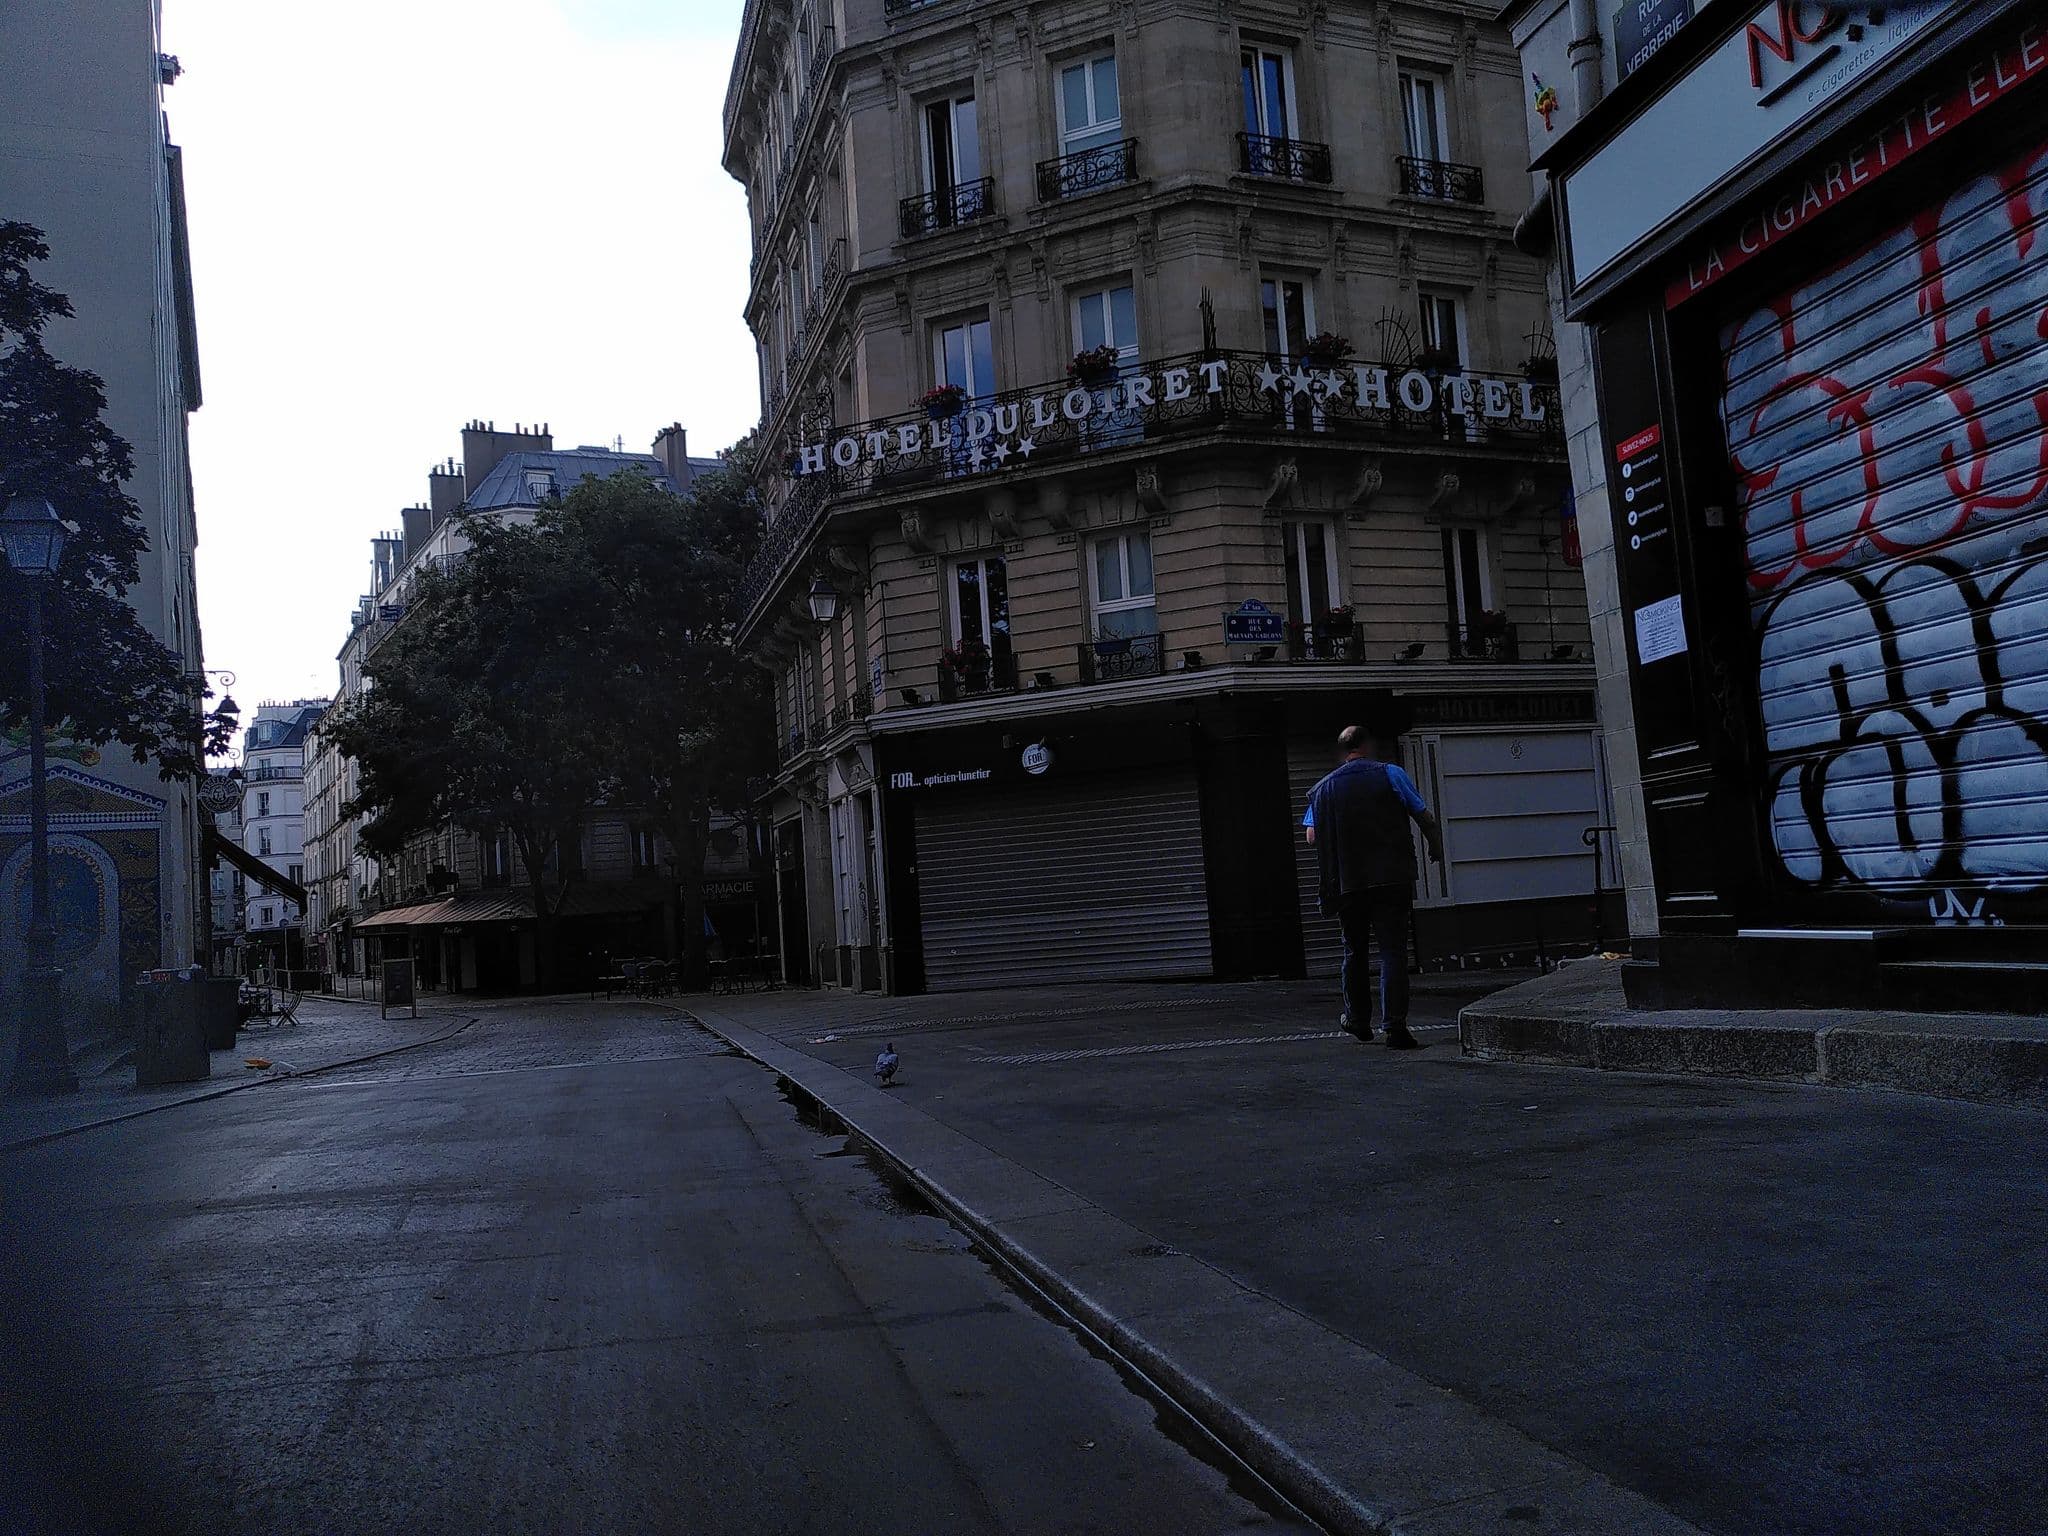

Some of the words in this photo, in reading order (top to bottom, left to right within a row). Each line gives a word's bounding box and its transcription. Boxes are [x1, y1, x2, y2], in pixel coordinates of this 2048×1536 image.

[1625, 11, 1684, 74] VERRERIE
[1687, 246, 1726, 292] LA
[1737, 91, 1947, 255] CIGARETTE
[1966, 21, 2046, 108] ELE
[800, 419, 953, 474] HOTEL
[967, 403, 1021, 441] DU
[1028, 359, 1228, 429] LOIRET
[1353, 366, 1546, 422] HOTEL
[1027, 752, 1044, 766] FOR
